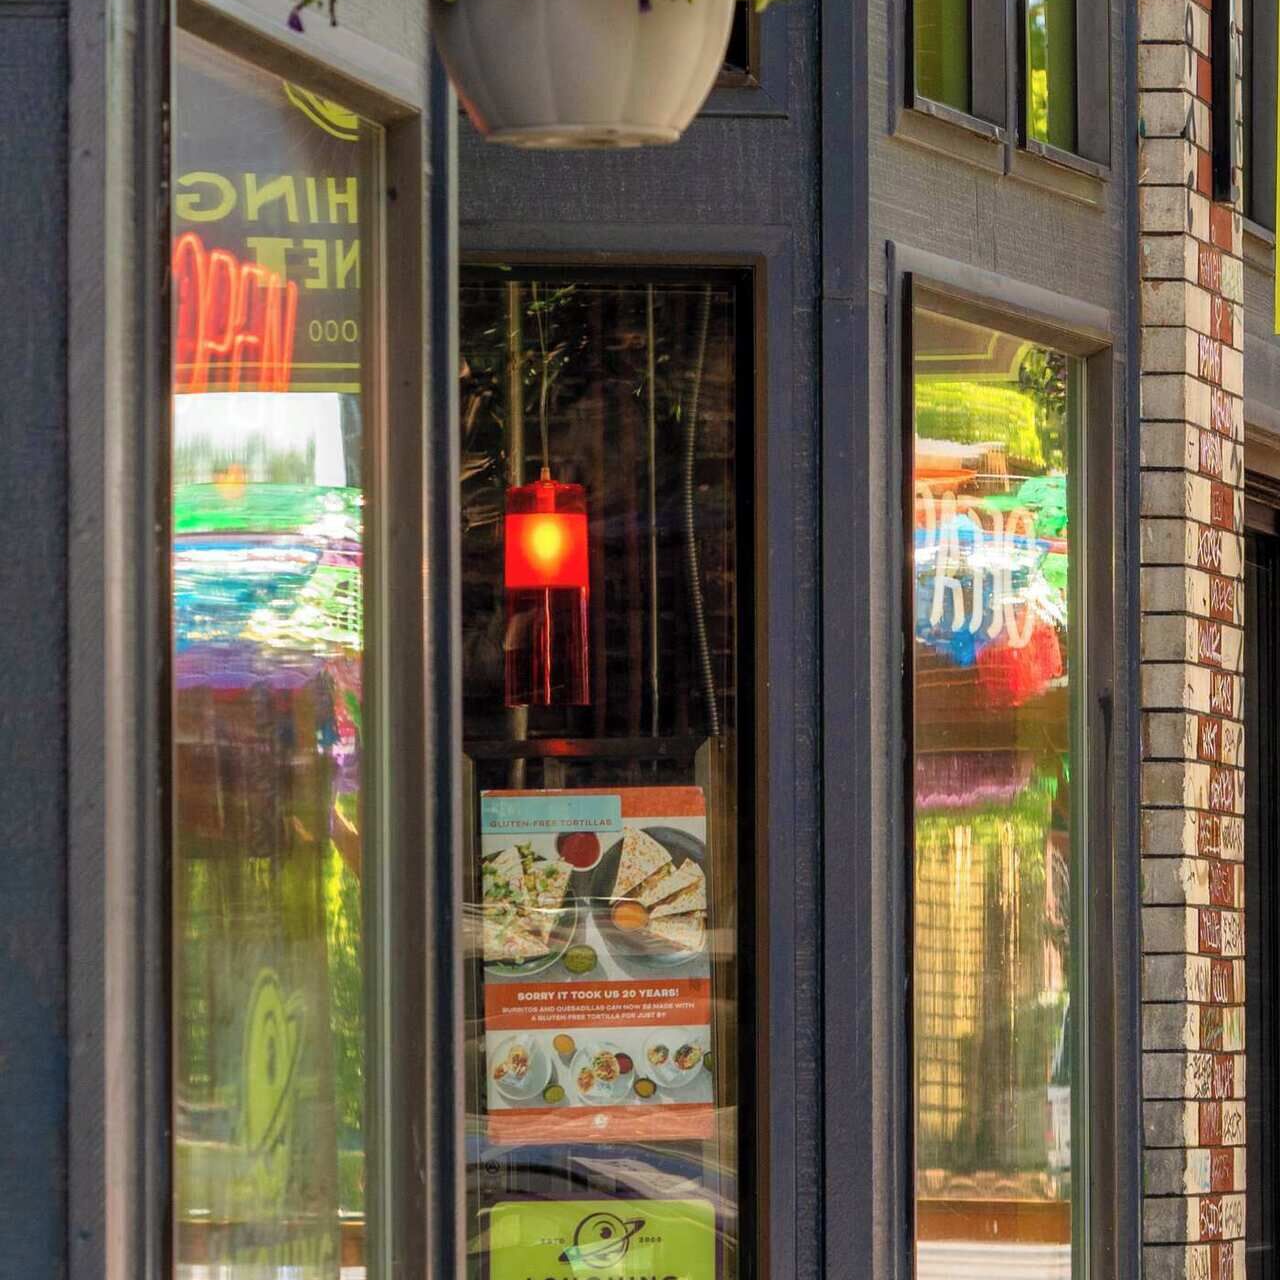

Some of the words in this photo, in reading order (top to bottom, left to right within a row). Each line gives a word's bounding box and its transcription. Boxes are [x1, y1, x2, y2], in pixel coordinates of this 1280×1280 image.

[173, 234, 297, 393] OPEN
[517, 991, 553, 1001] SORRY
[557, 991, 568, 1000] IT
[570, 990, 600, 1000] TOOK
[604, 990, 620, 999] US
[623, 989, 637, 998] 20
[639, 987, 680, 998] YEARS!
